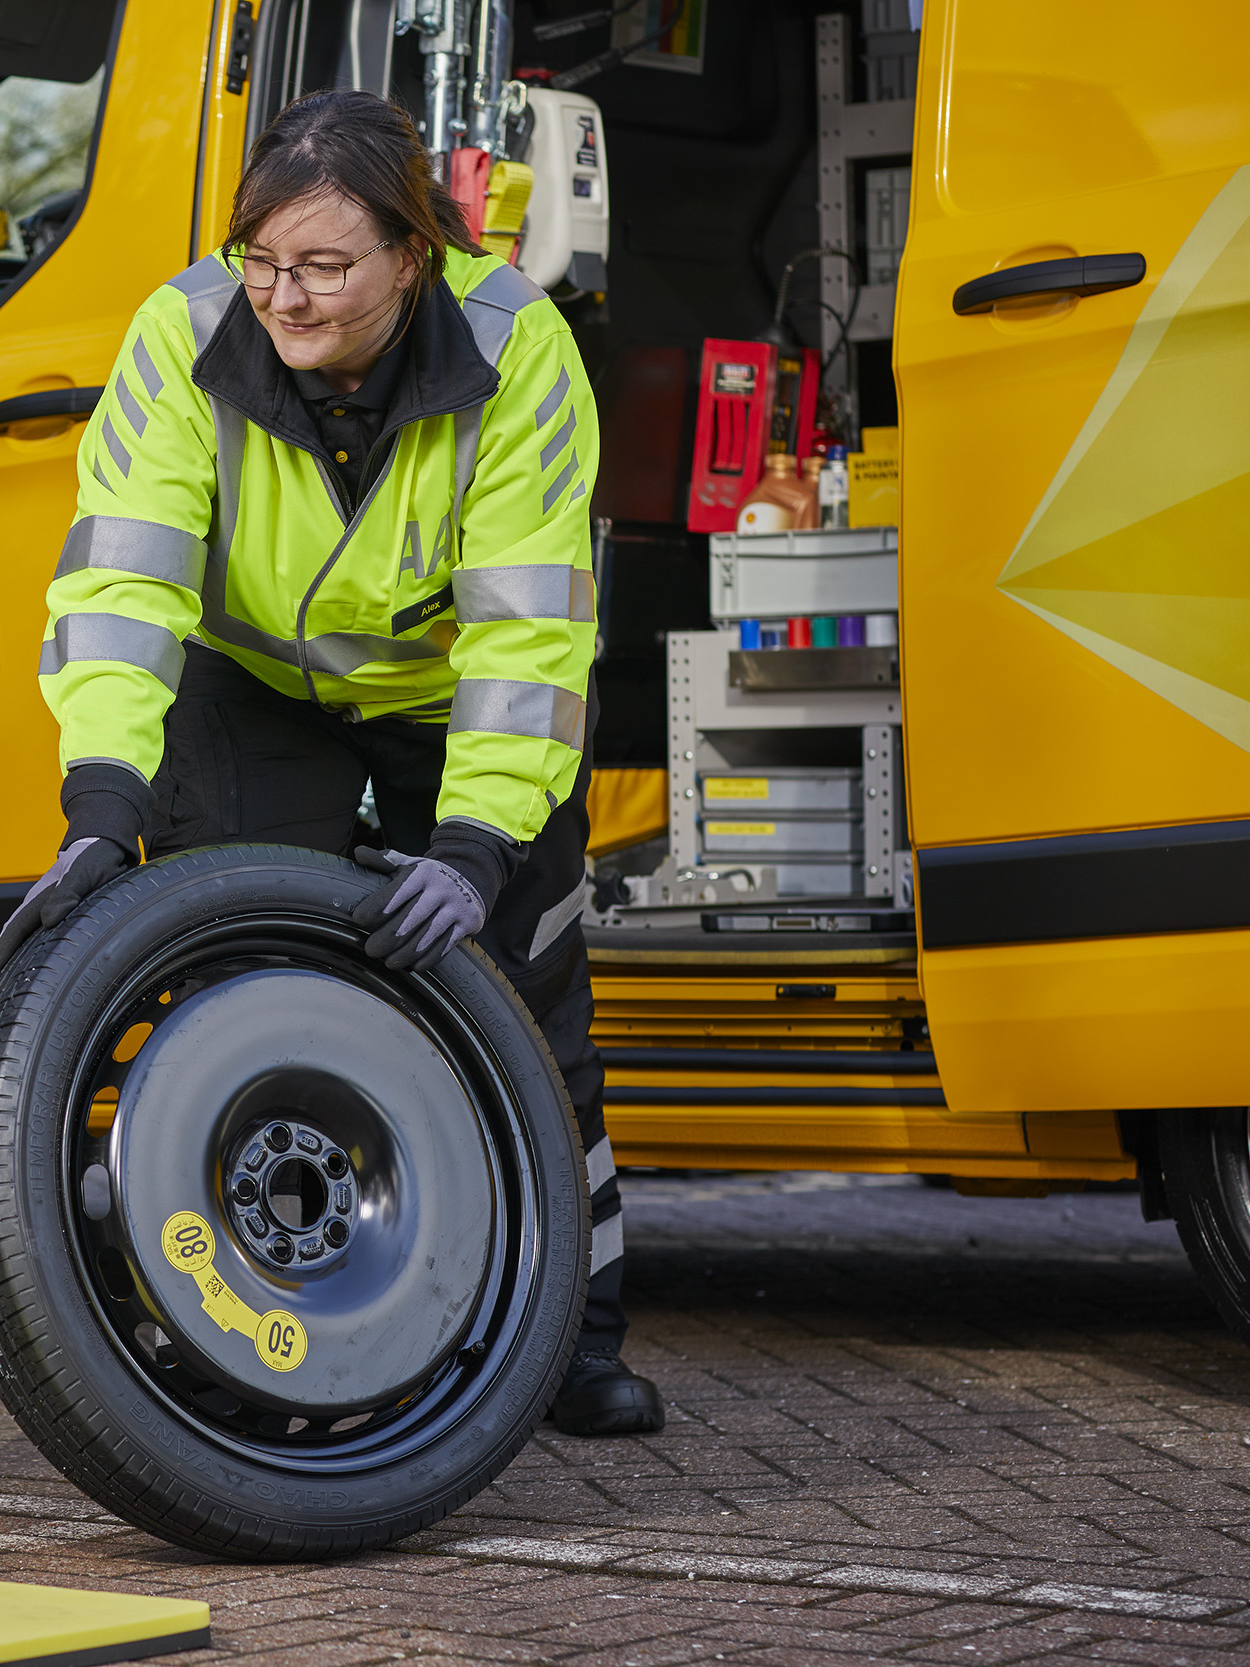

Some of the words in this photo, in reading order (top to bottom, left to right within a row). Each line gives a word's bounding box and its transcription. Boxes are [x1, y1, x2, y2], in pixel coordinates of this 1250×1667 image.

[396, 512, 452, 588] AA
[421, 600, 441, 617] Alex
[439, 868, 472, 903] uvex
[29, 1055, 57, 1196] TEMPORARY
[49, 1007, 78, 1051] USE
[70, 958, 105, 1008] ONLY
[558, 1169, 575, 1253] INFLATE
[175, 1225, 208, 1259] 80
[549, 1228, 562, 1276] VEHICLE
[558, 1259, 573, 1288] TO
[549, 1293, 568, 1328] 420
[268, 1320, 295, 1359] 50
[271, 1359, 283, 1369] MAX
[129, 1400, 215, 1479] YANG
[252, 1481, 350, 1511] CHAO
